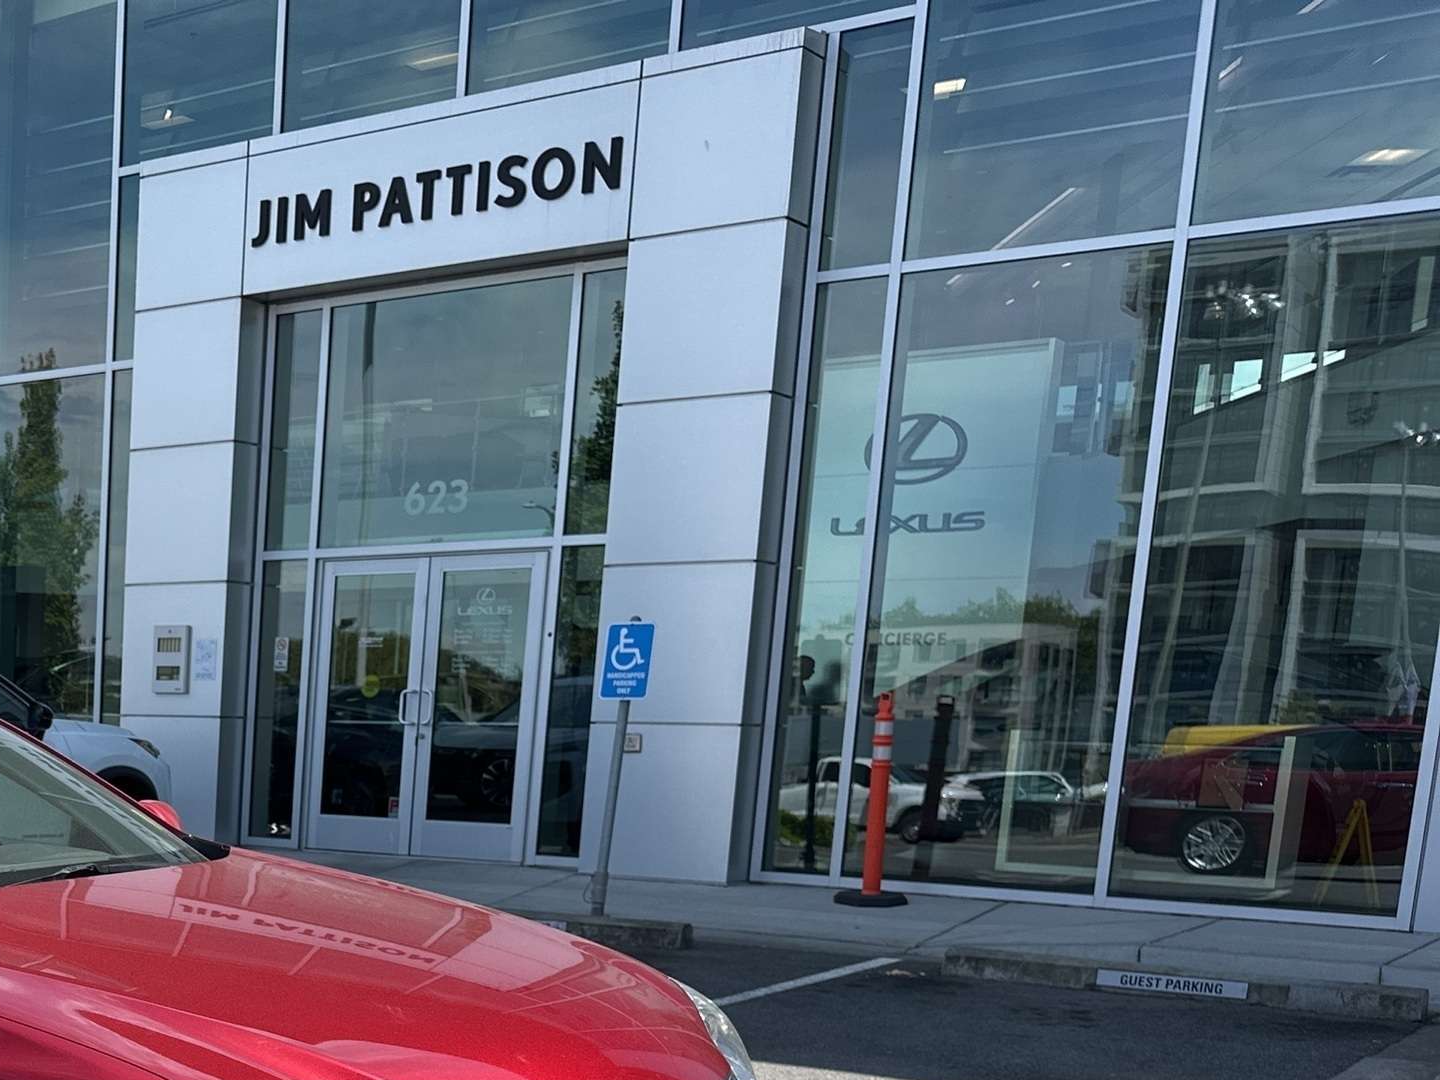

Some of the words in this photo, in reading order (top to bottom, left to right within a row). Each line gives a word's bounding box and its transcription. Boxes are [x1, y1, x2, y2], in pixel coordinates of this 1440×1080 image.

[251, 188, 333, 248] JIM
[351, 136, 625, 232] PATTISON
[404, 479, 469, 516] 623
[457, 605, 513, 616] LEXUS
[845, 631, 948, 648] CCIERGE
[1120, 974, 1162, 989] GUEST
[1165, 978, 1224, 995] PARKING
